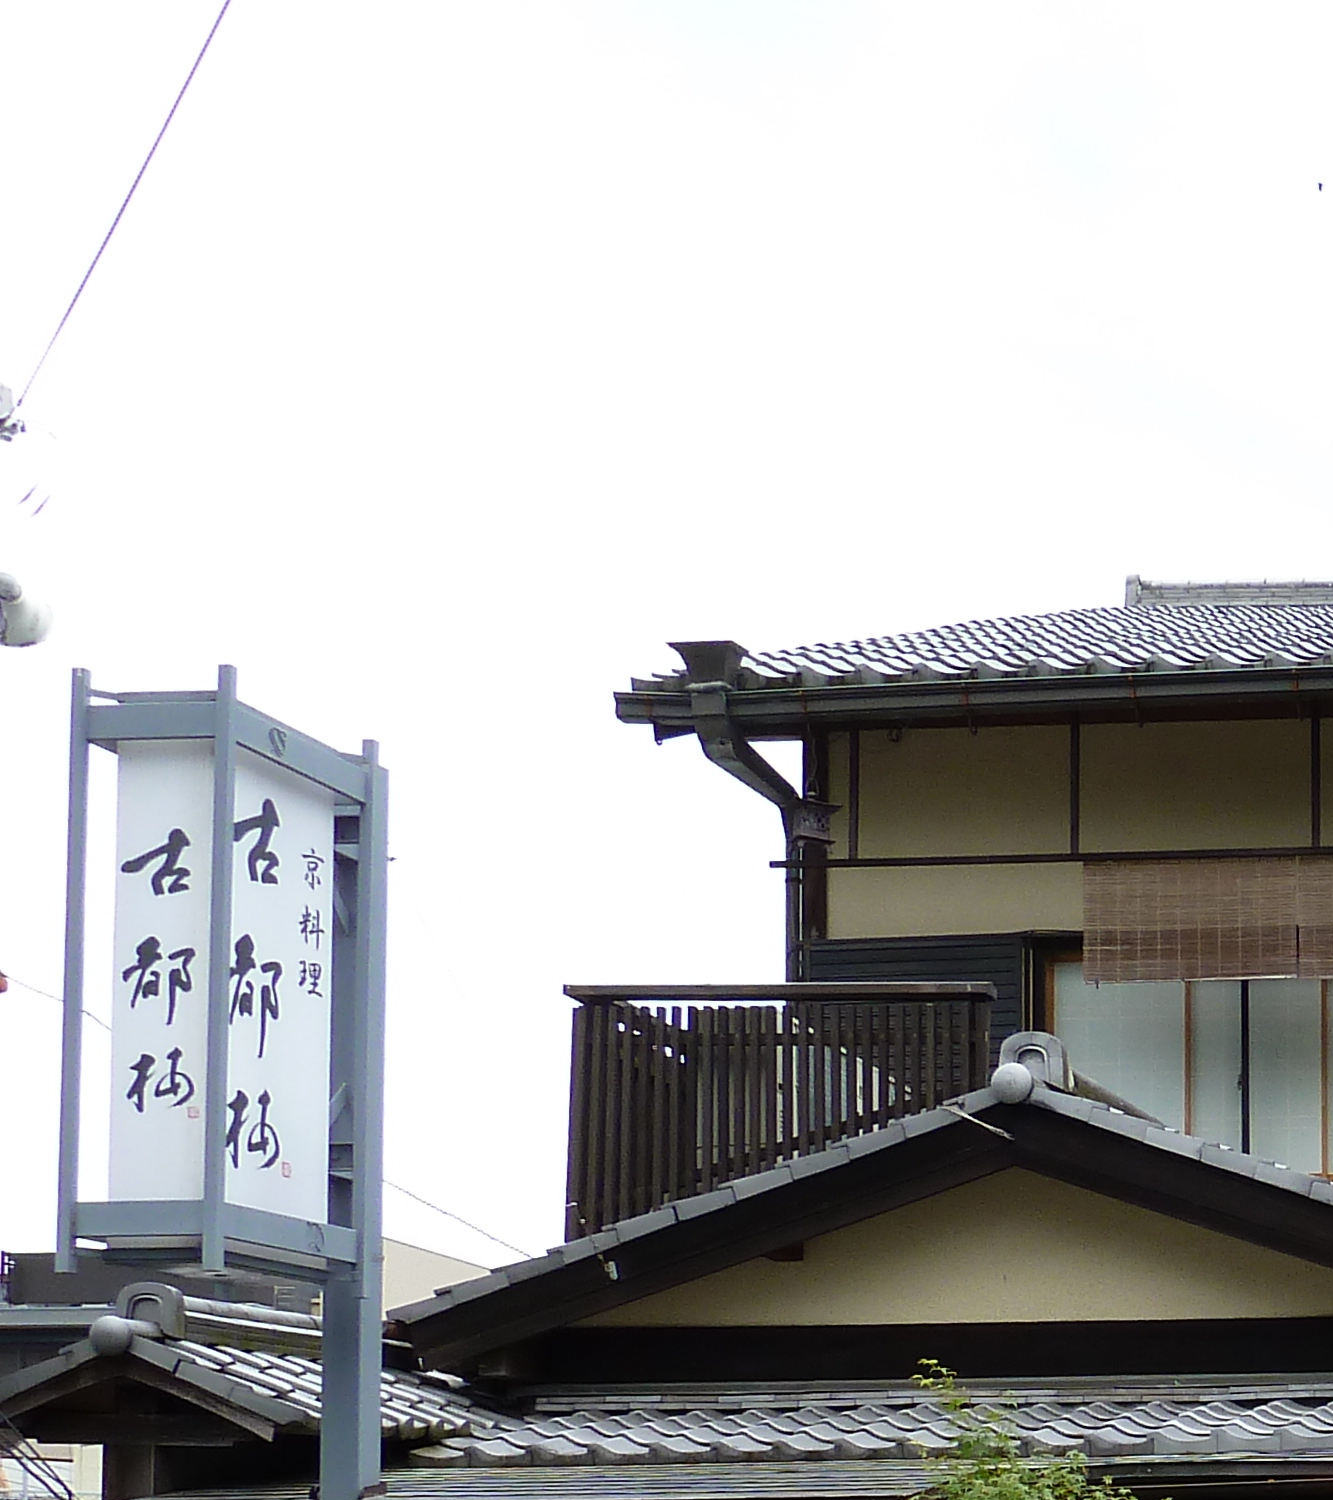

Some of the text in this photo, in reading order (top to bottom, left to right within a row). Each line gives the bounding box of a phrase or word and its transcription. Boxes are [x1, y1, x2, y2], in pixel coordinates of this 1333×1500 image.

[121, 828, 196, 1112] 古都梅
[225, 798, 282, 1170] 古都梅
[298, 848, 326, 998] 京料理
